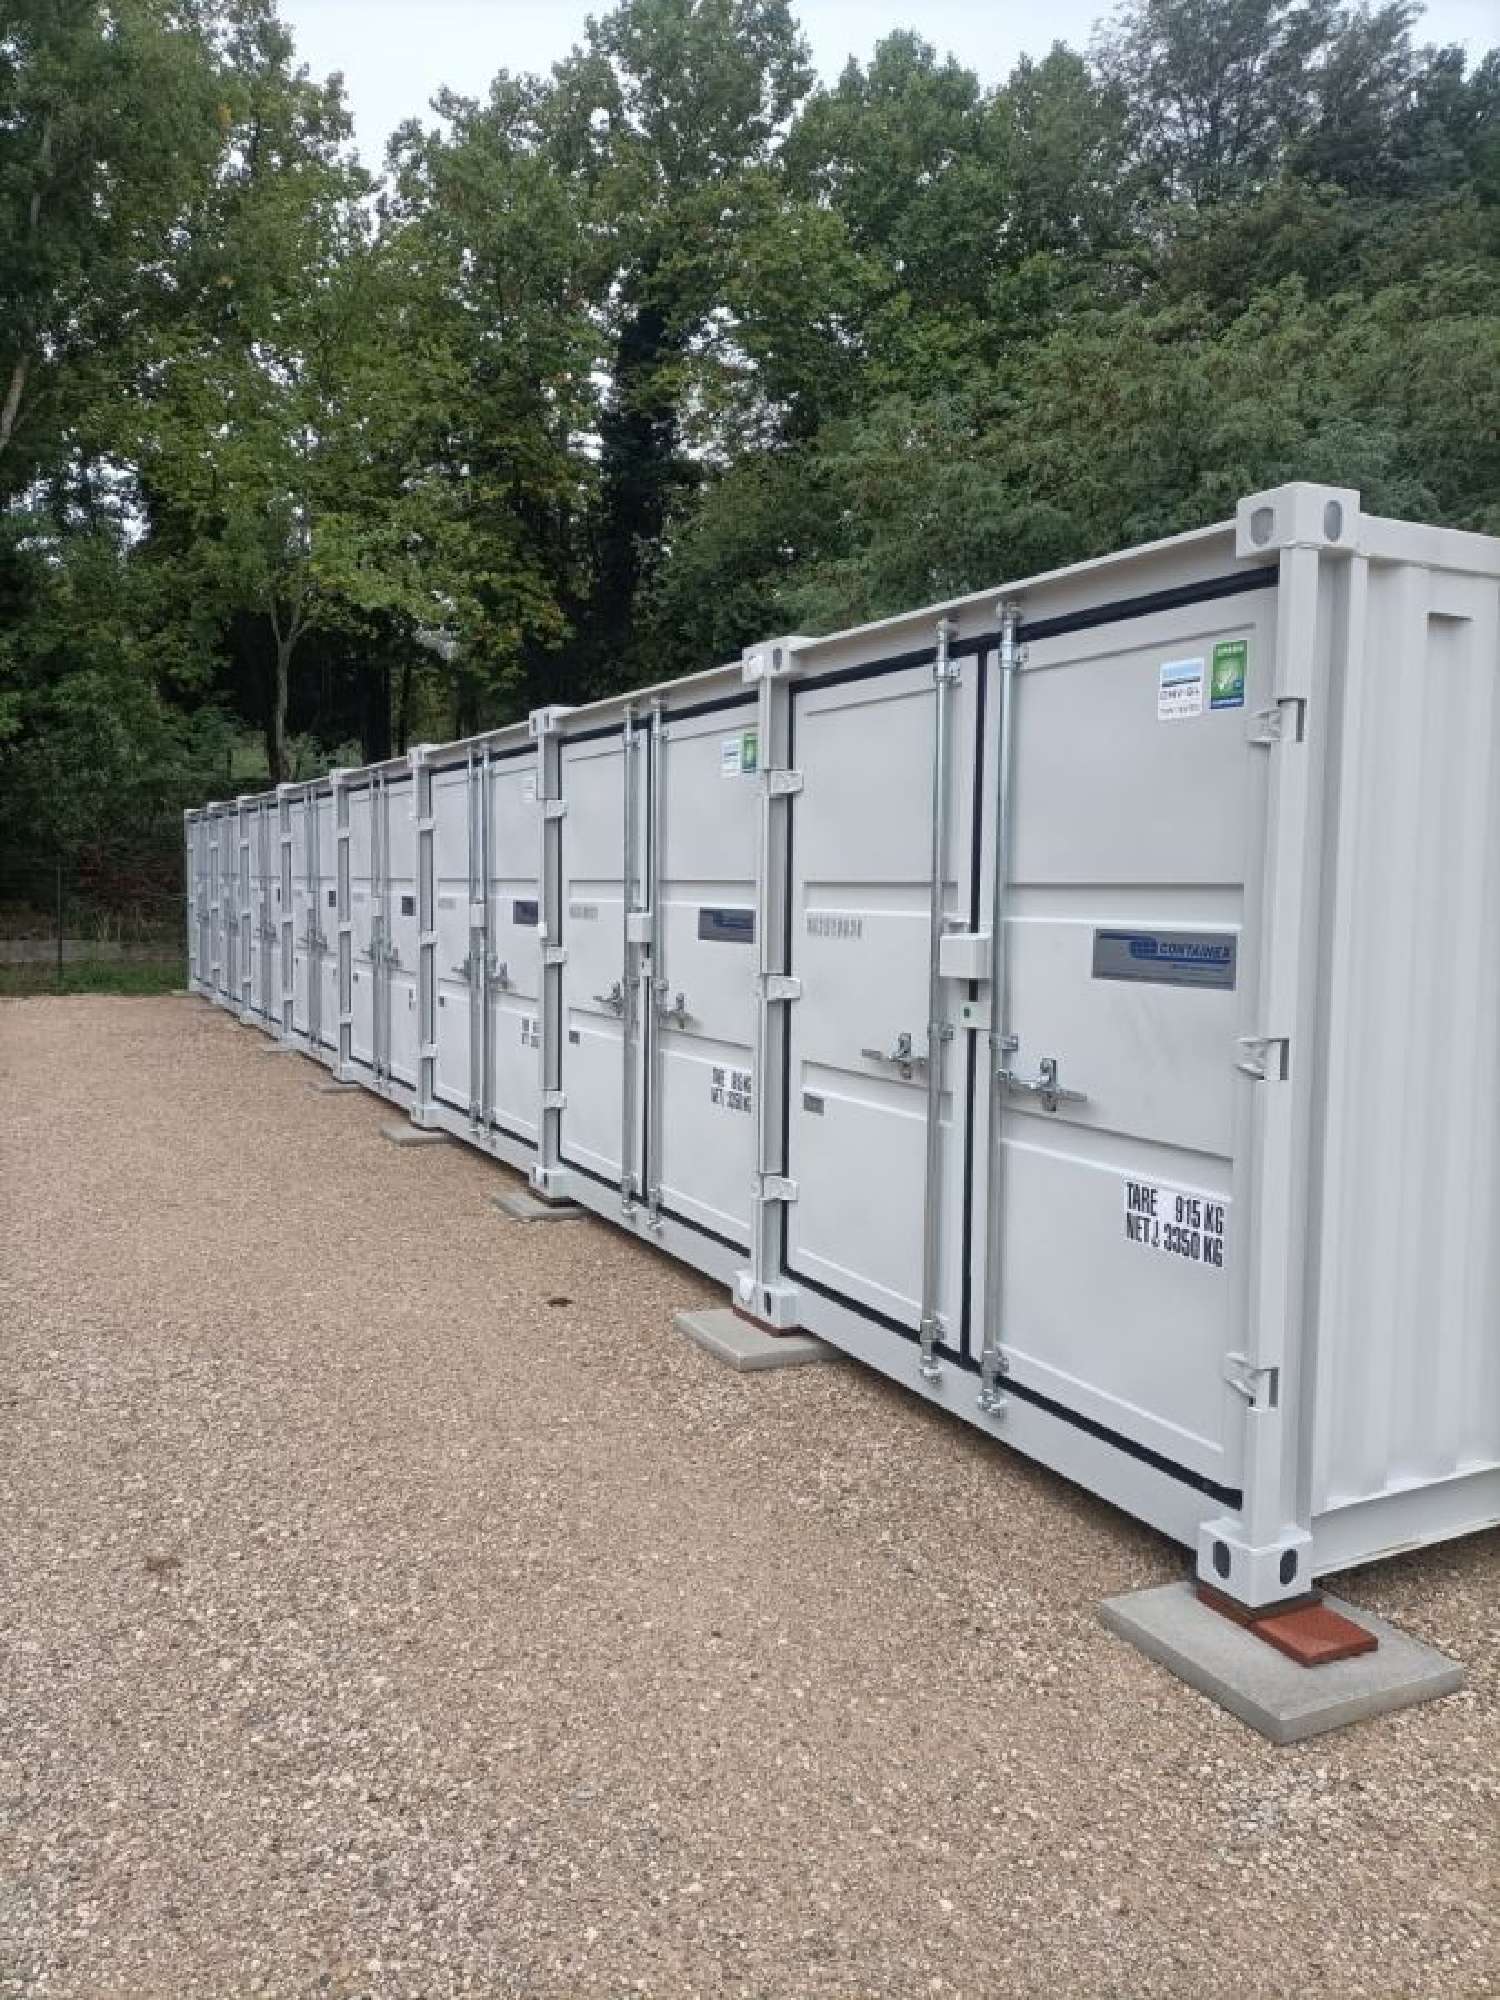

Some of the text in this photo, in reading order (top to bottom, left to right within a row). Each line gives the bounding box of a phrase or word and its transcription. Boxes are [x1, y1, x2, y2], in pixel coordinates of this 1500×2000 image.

[1159, 942, 1231, 959] CONTAINER
[1126, 1181, 1159, 1217] TARE
[1203, 1202, 1224, 1236] KG
[1163, 1223, 1200, 1261] 3350
[1203, 1235, 1223, 1268] KG
